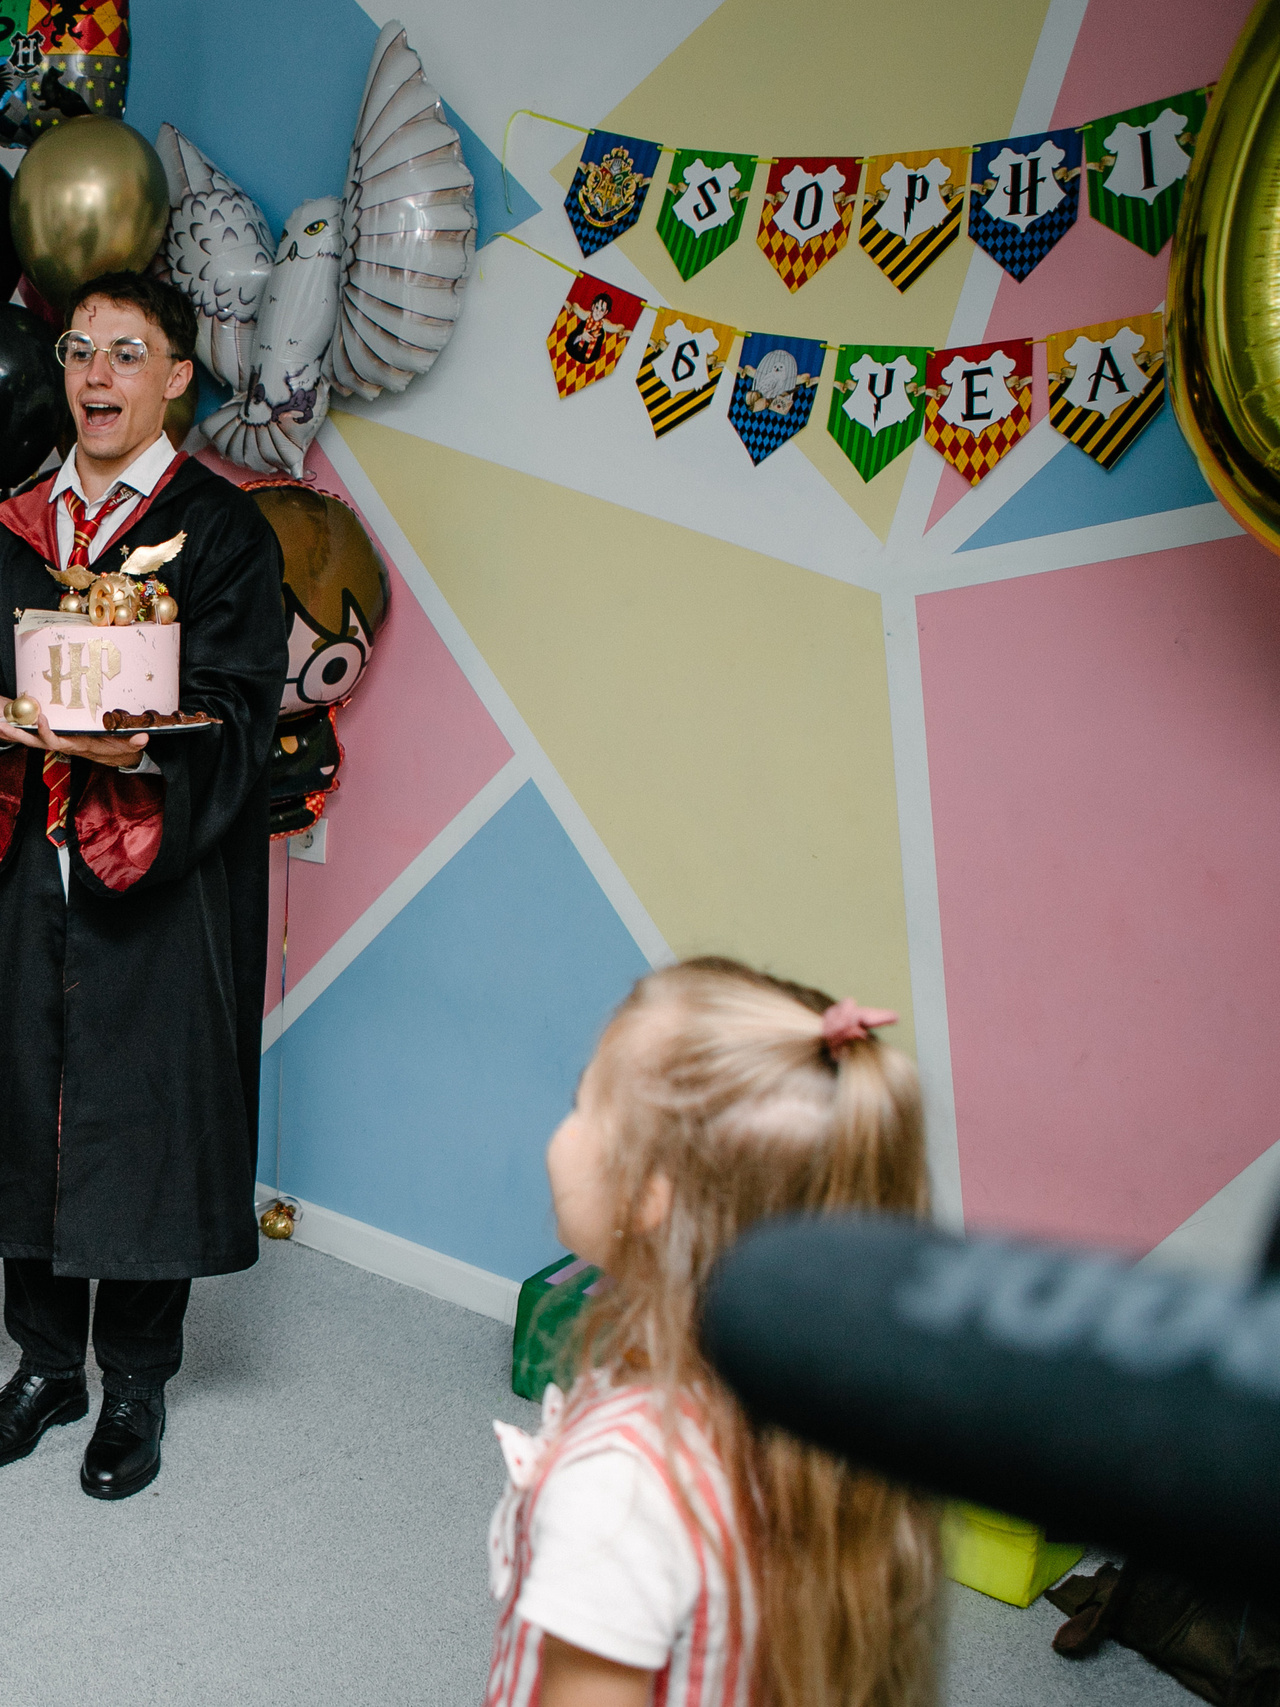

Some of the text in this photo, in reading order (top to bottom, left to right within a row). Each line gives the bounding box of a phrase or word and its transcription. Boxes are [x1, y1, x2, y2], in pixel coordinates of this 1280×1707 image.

[671, 339, 700, 382] 6
[89, 579, 115, 626] 6
[42, 637, 121, 724] HP
